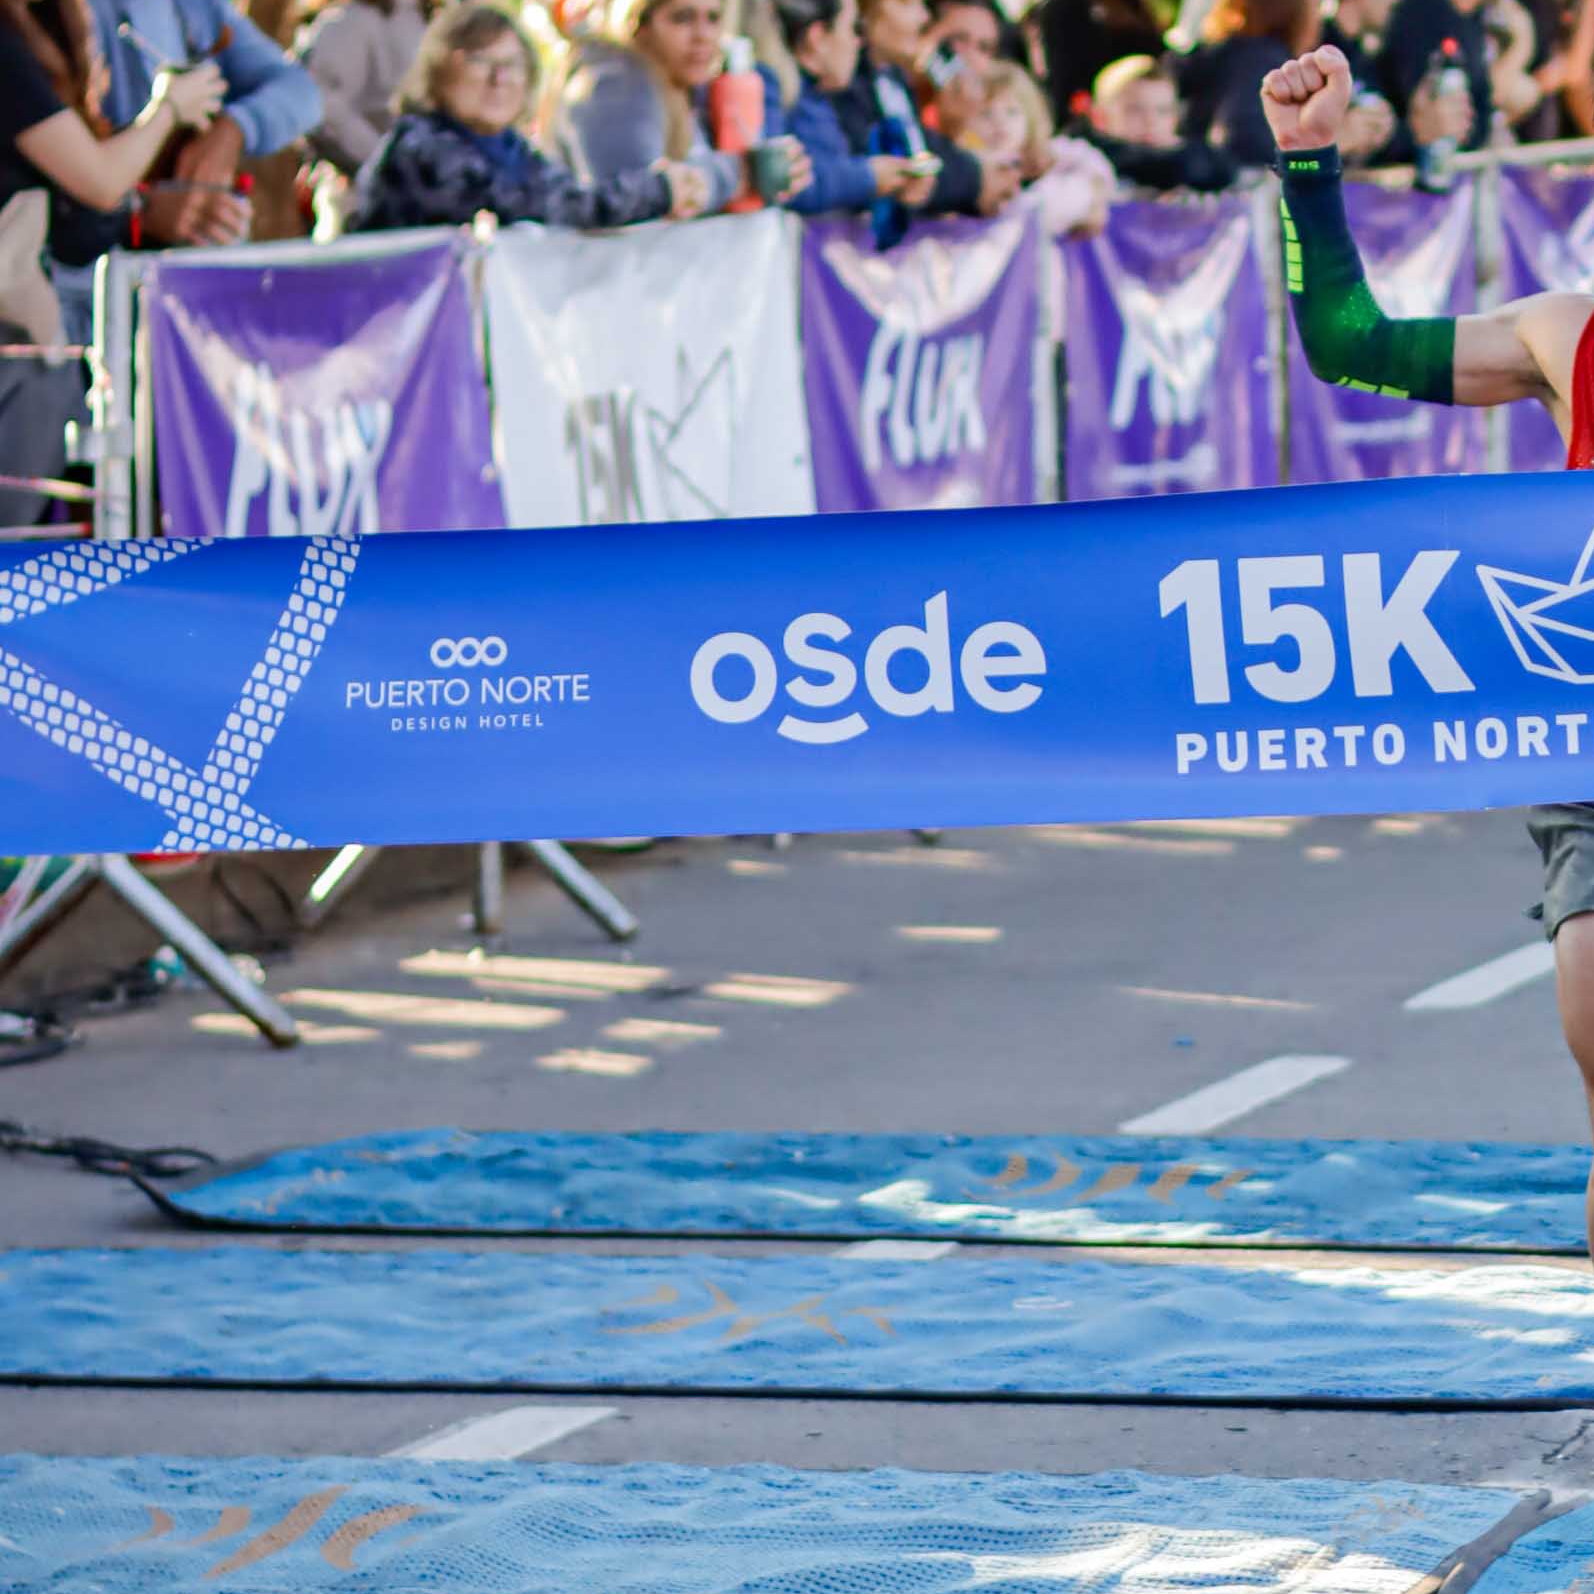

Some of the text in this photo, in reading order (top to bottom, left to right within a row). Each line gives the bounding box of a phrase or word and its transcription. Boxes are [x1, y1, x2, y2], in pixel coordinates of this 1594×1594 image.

[1159, 550, 1475, 704] 15K
[690, 590, 1047, 723] osde
[346, 674, 591, 709] PUERTO NORTE
[391, 714, 544, 731] DESIGN HOTEL
[1176, 723, 1406, 774] PUERTO
